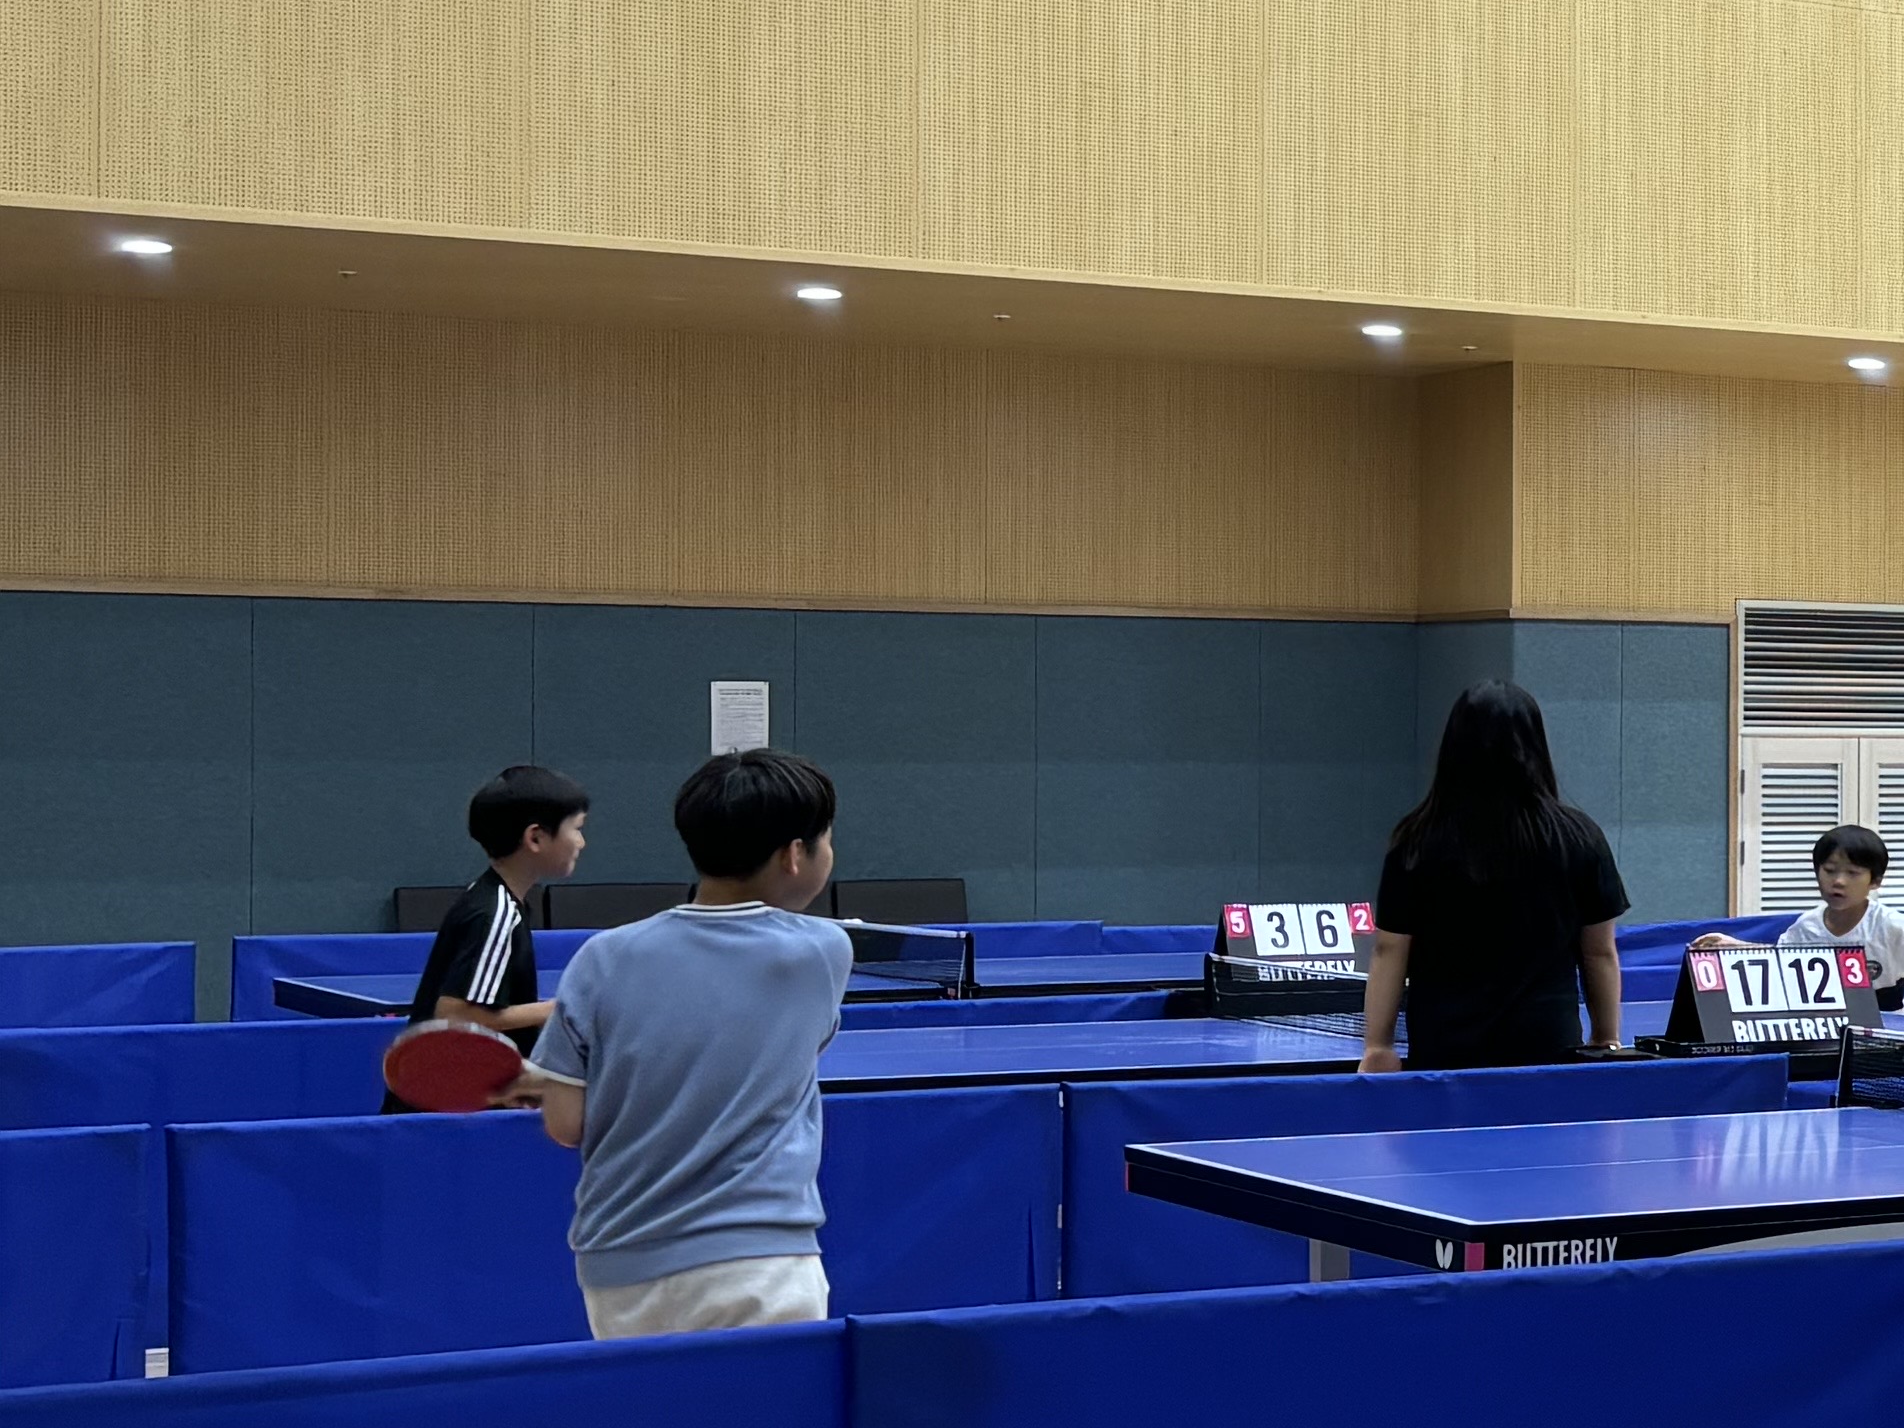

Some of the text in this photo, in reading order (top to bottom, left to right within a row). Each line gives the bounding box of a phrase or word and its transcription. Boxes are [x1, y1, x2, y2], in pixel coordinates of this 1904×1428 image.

[1229, 908, 1370, 949] 5 3 6 2
[1697, 956, 1864, 1006] 0 17 12 3
[1503, 1236, 1618, 1270] BUTTERFLY
